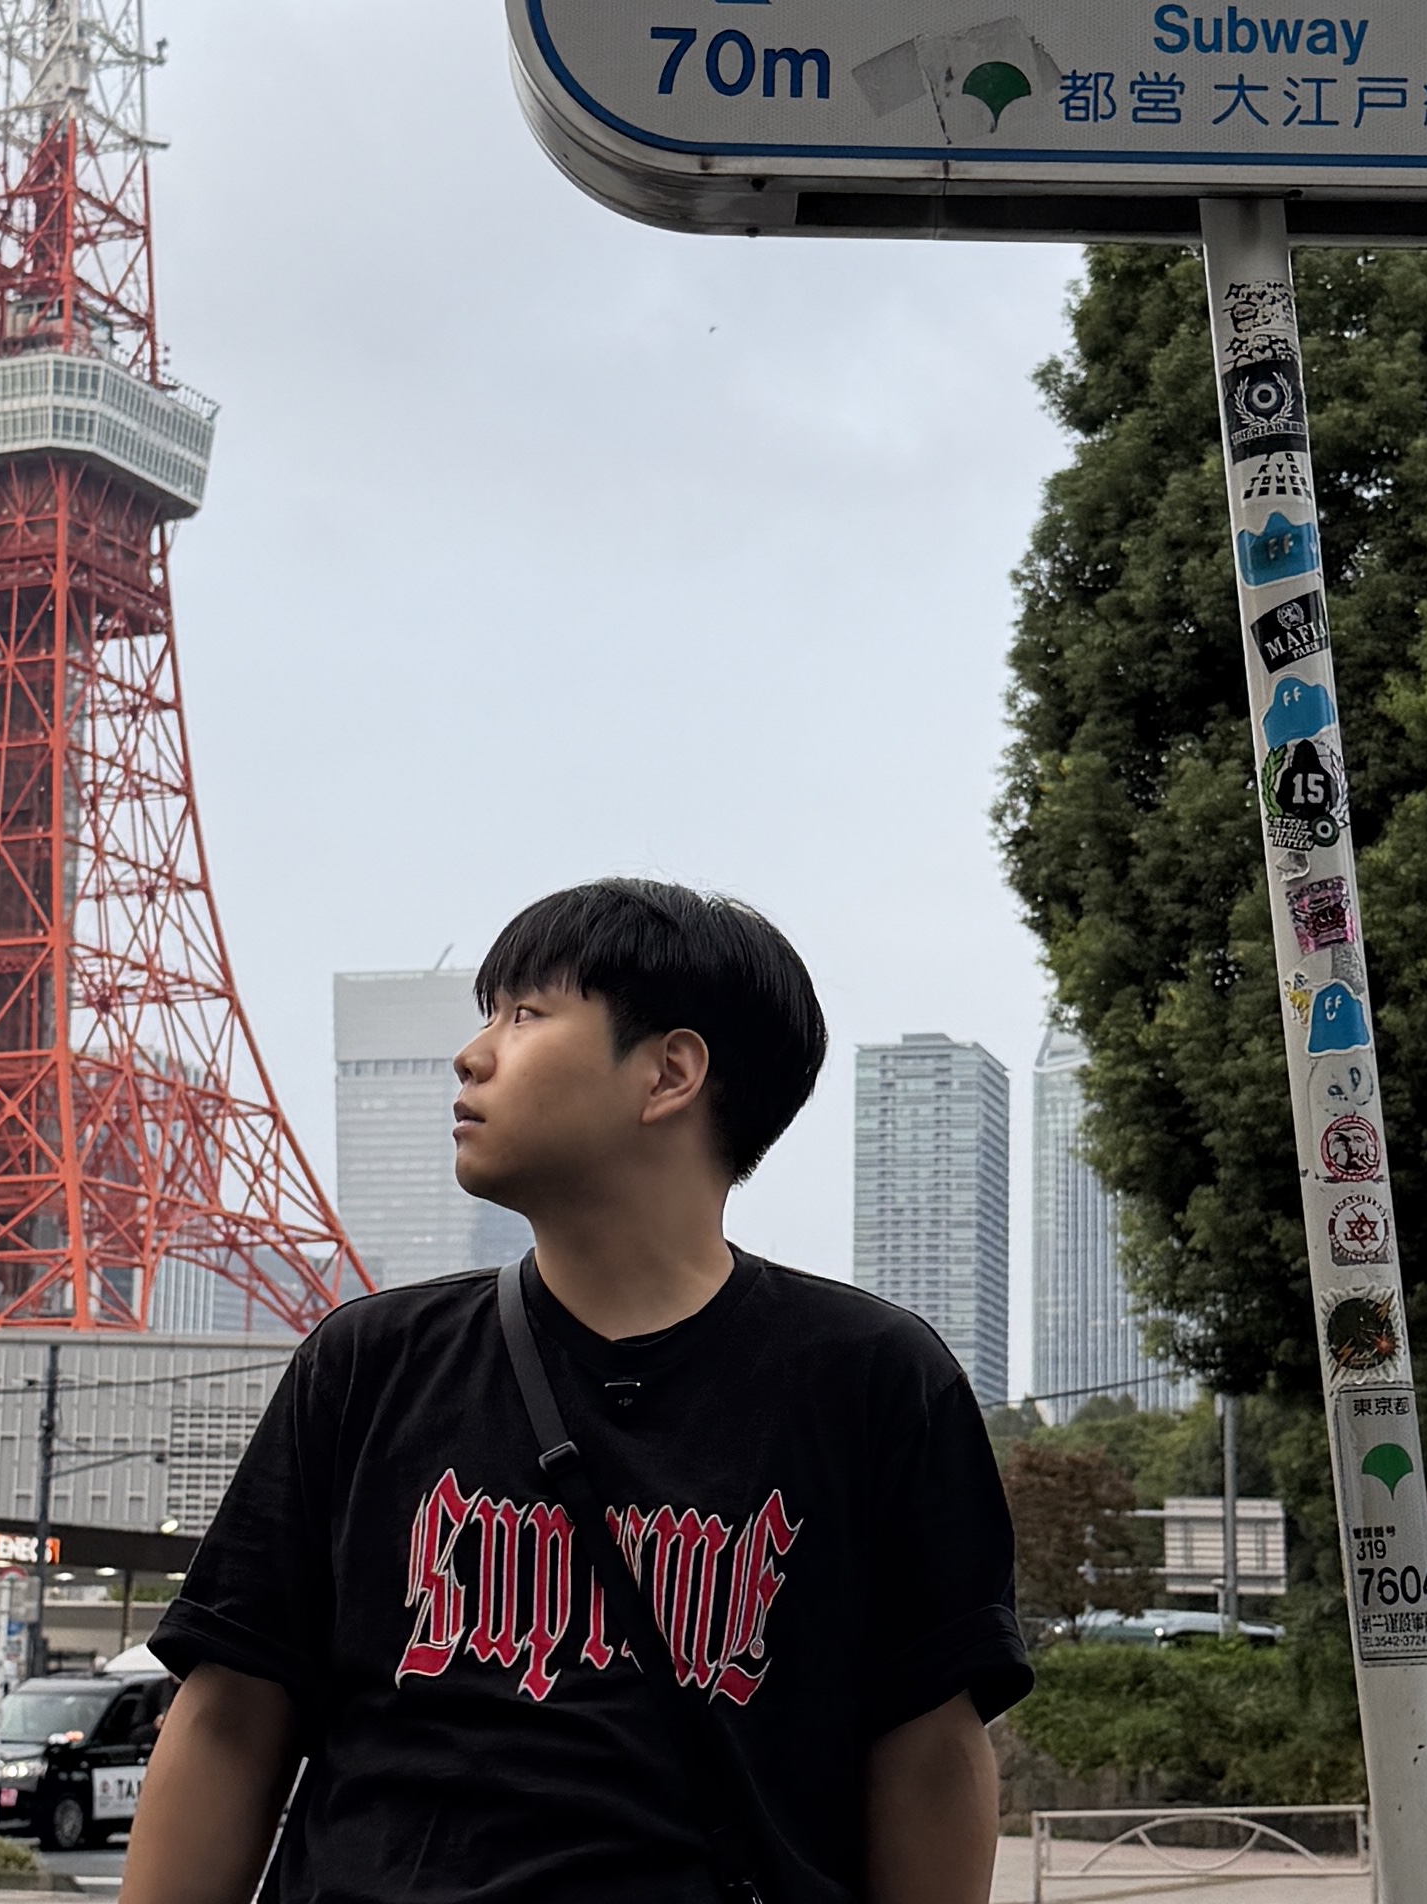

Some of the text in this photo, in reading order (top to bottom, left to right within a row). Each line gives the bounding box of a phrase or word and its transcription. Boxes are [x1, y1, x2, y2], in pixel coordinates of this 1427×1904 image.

[1153, 4, 1369, 65] Subway
[650, 26, 831, 100] 70m
[1292, 773, 1325, 804] 15
[1353, 1397, 1411, 1416] 東京都
[1356, 1539, 1387, 1561] 319
[116, 1778, 142, 1801] TA
